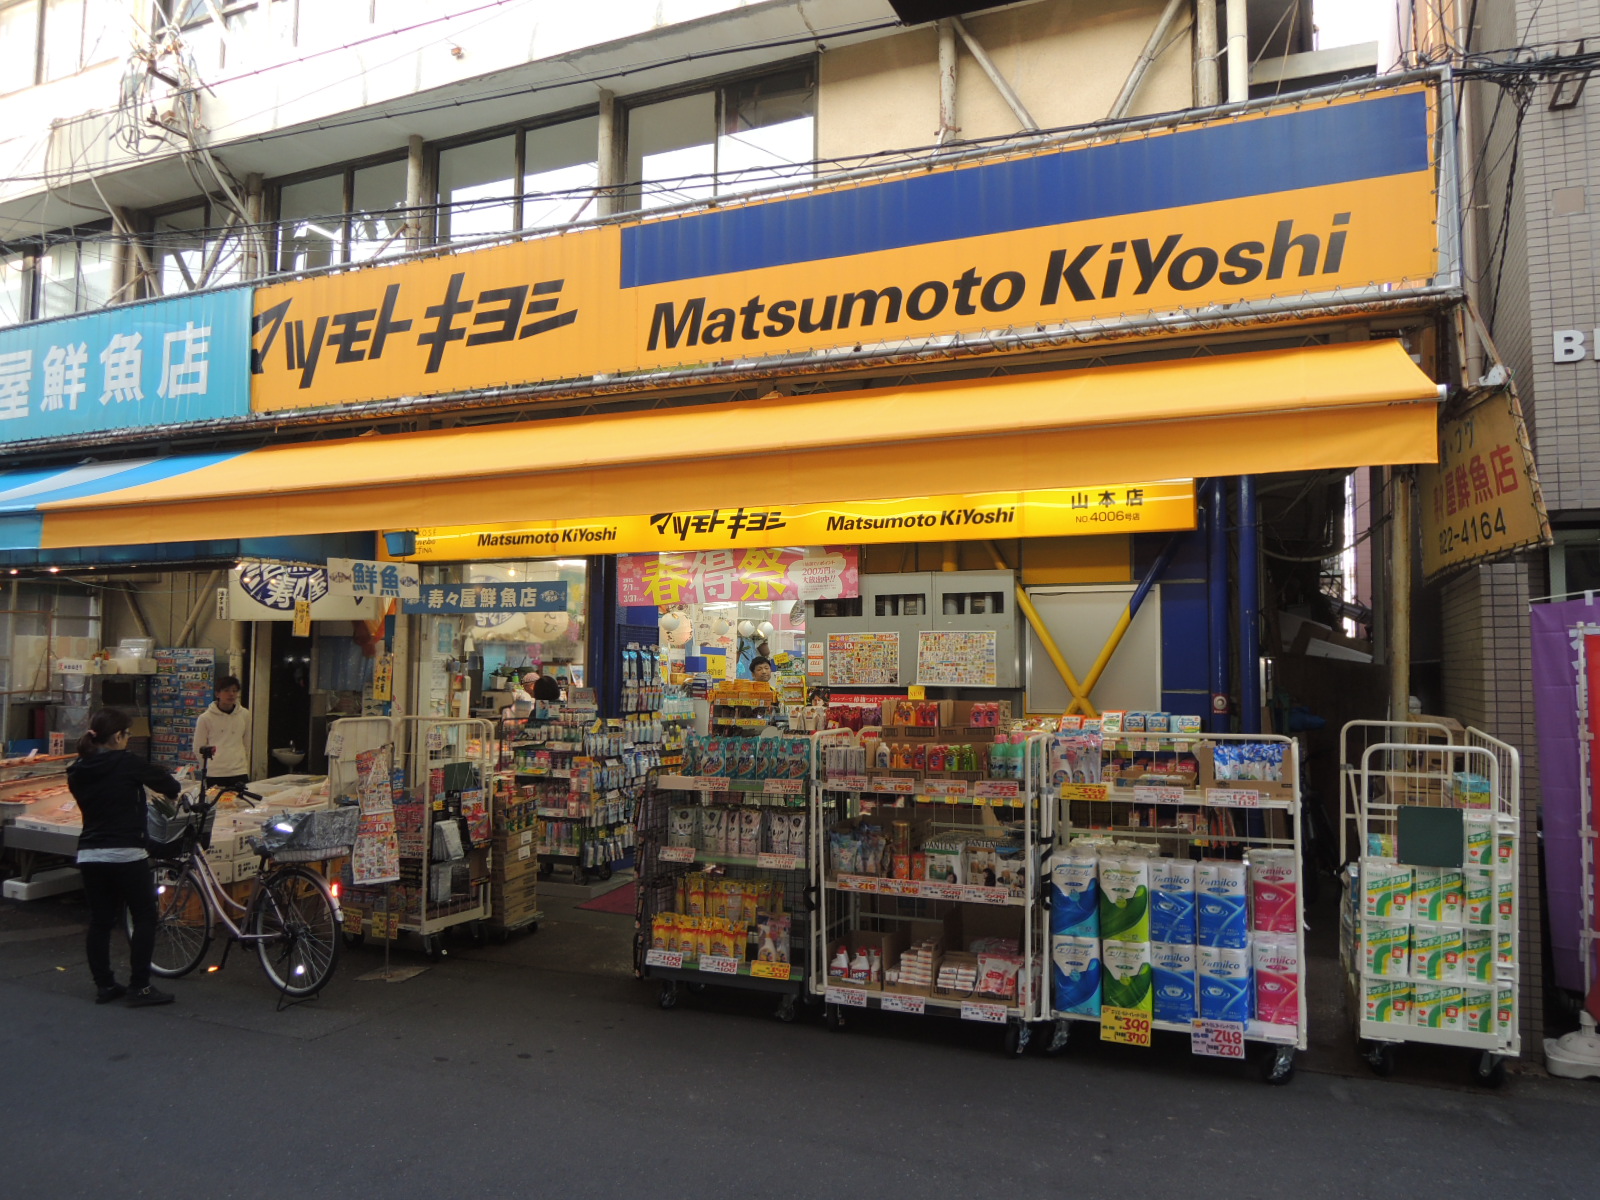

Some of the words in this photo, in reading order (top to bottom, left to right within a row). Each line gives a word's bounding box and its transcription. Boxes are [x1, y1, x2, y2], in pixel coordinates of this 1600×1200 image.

[646, 267, 1027, 352] Matsumoto
[1038, 211, 1351, 307] KiYoshi
[250, 271, 578, 389] マツモトキヨシ
[1553, 329, 1600, 363] B
[0, 319, 212, 420] 屋鮮魚店
[1071, 489, 1145, 510] 山本店
[650, 507, 787, 541] マツモトキヨシ
[826, 513, 937, 532] Matsumoto
[939, 507, 1015, 526] KiYoshi
[477, 531, 560, 548] Matsumoto
[561, 526, 617, 543] KiYoshi
[352, 562, 400, 598] 鮮魚
[641, 549, 787, 606] 春得祭
[428, 587, 538, 609] 寿々屋鮮魚店
[705, 668, 724, 676] ashier
[925, 841, 960, 851] PANTENE
[1123, 1018, 1149, 1032] 399
[1213, 1029, 1242, 1044] 248
[1219, 1044, 1241, 1056] 230
